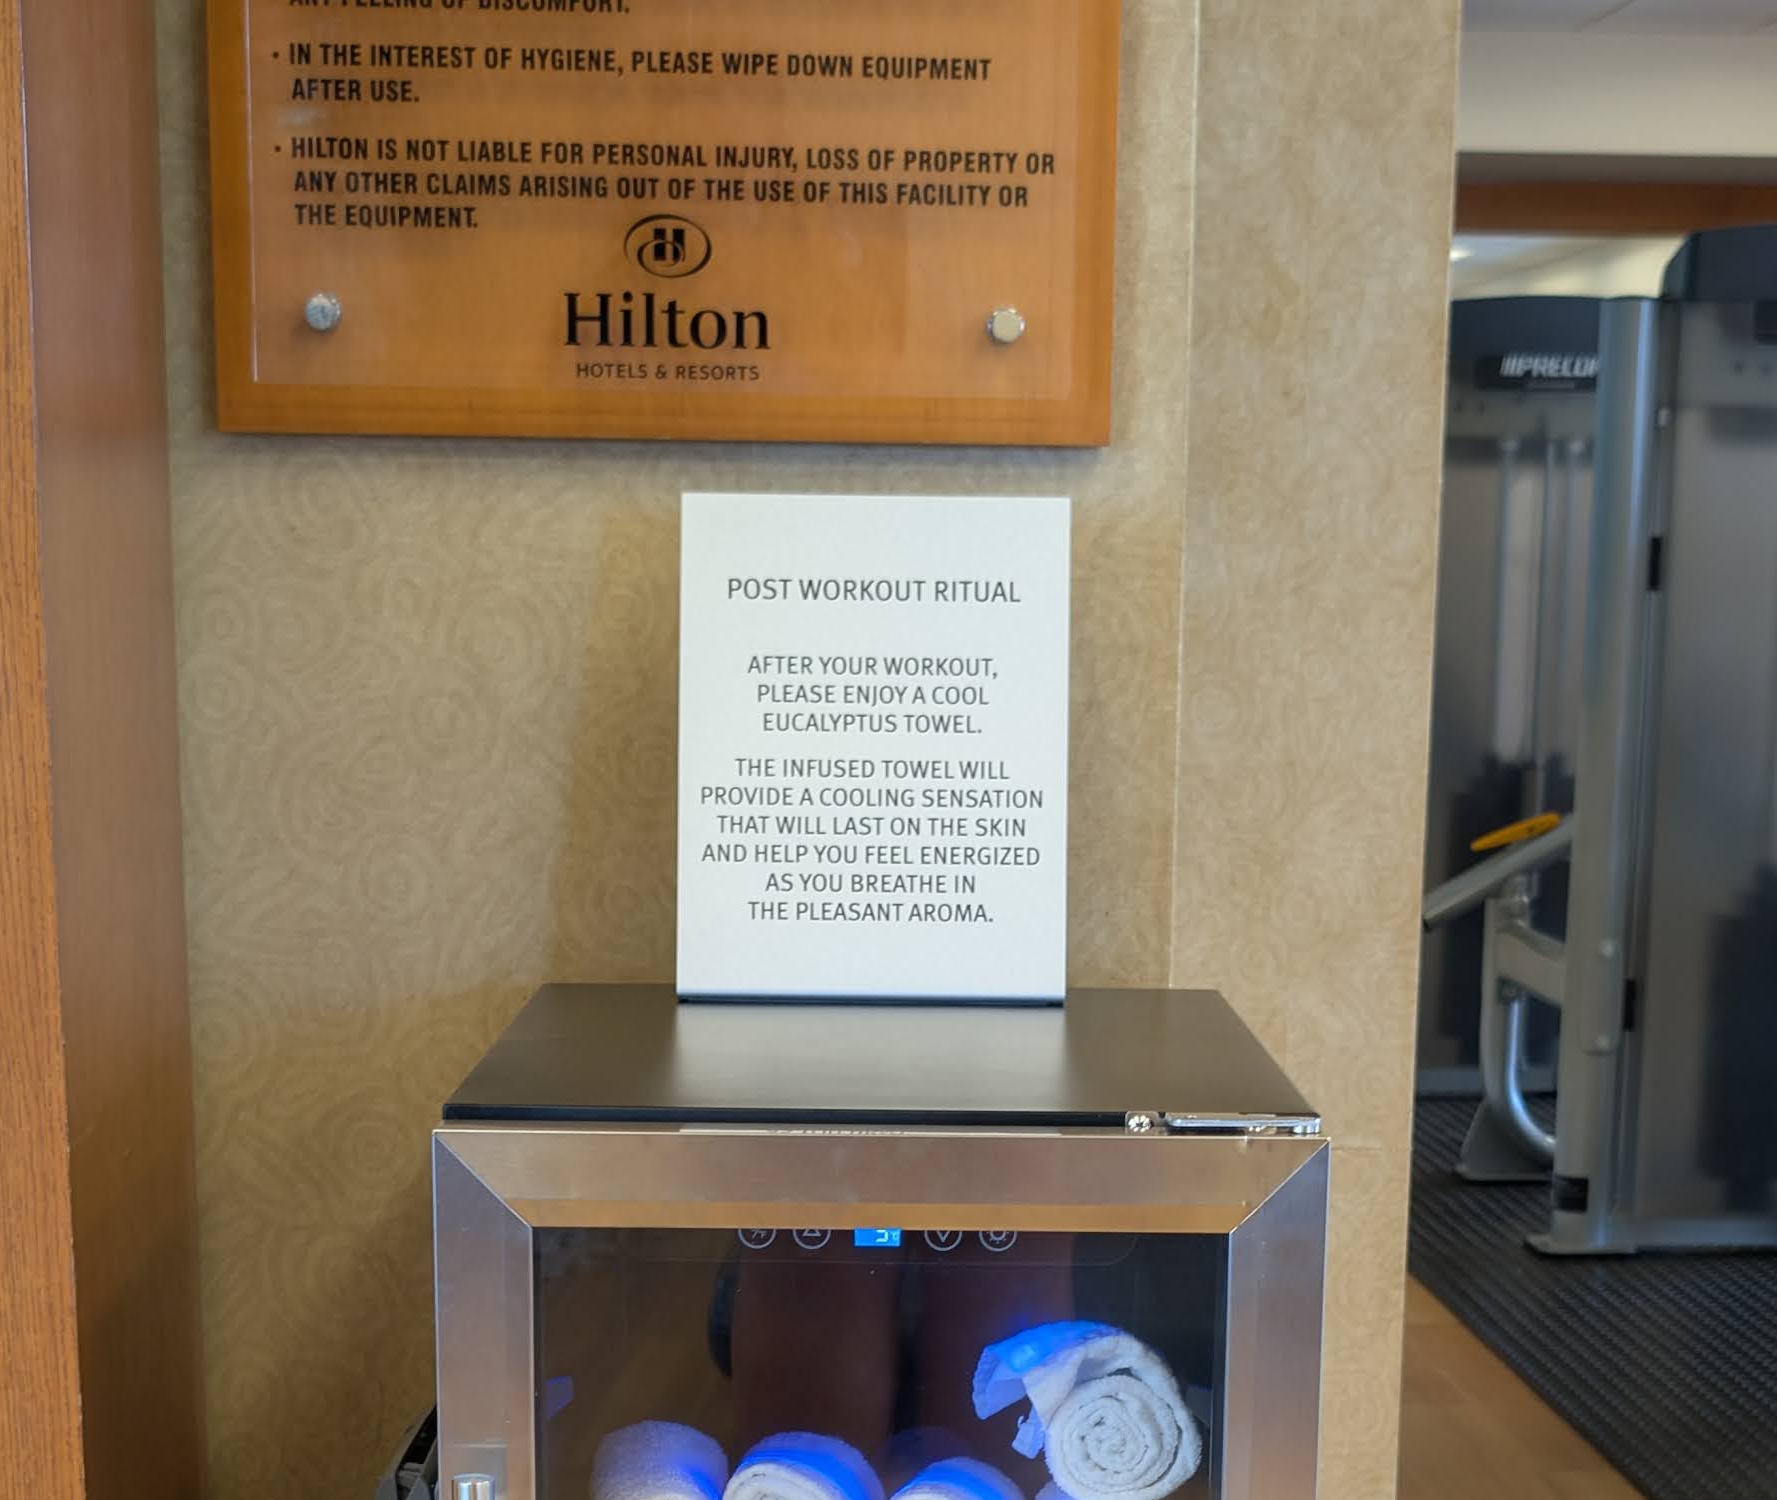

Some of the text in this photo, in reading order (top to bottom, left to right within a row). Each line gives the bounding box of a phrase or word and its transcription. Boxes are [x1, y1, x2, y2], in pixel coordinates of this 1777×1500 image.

[290, 43, 992, 80] IN THE INTEREST OF HYGIENE, PLEASE WIPE DOWN EQUIPMENT
[292, 78, 419, 102] AFTER USE.
[292, 136, 1054, 174] HILTON IS NOT LIABLE FOR PERSONAL INJURY, LOSS OF PROPERTY OR
[294, 170, 1028, 207] ANY OTHER CLAIMS ARISING OUT OF THE USE OF THIS FACILITY OR
[295, 204, 478, 228] THE EQUIPMENT.
[563, 291, 771, 350] Hilton
[576, 360, 760, 381] HOTELS & RESORTS
[728, 578, 1021, 602] POST WORKOUT RITUAL
[747, 656, 997, 679] AFTER YOUR WORKOUT,
[758, 684, 989, 707] PLEASE ENJOY A COOL
[763, 713, 982, 734] EUCALYPTUS TOWEL.
[734, 758, 1010, 779] THE INFUSED TOWEL WILL
[701, 786, 1043, 808] PROVIDE A COOLING SENSATION
[716, 815, 1026, 837] THAT WILL LAST ON THE SKIN
[702, 844, 1040, 865] AND HELP YOU FEEL ENERGIZED
[765, 873, 975, 894] AS YOU BREATHE IN
[747, 901, 993, 922] THE PLEASANT AROMA.
